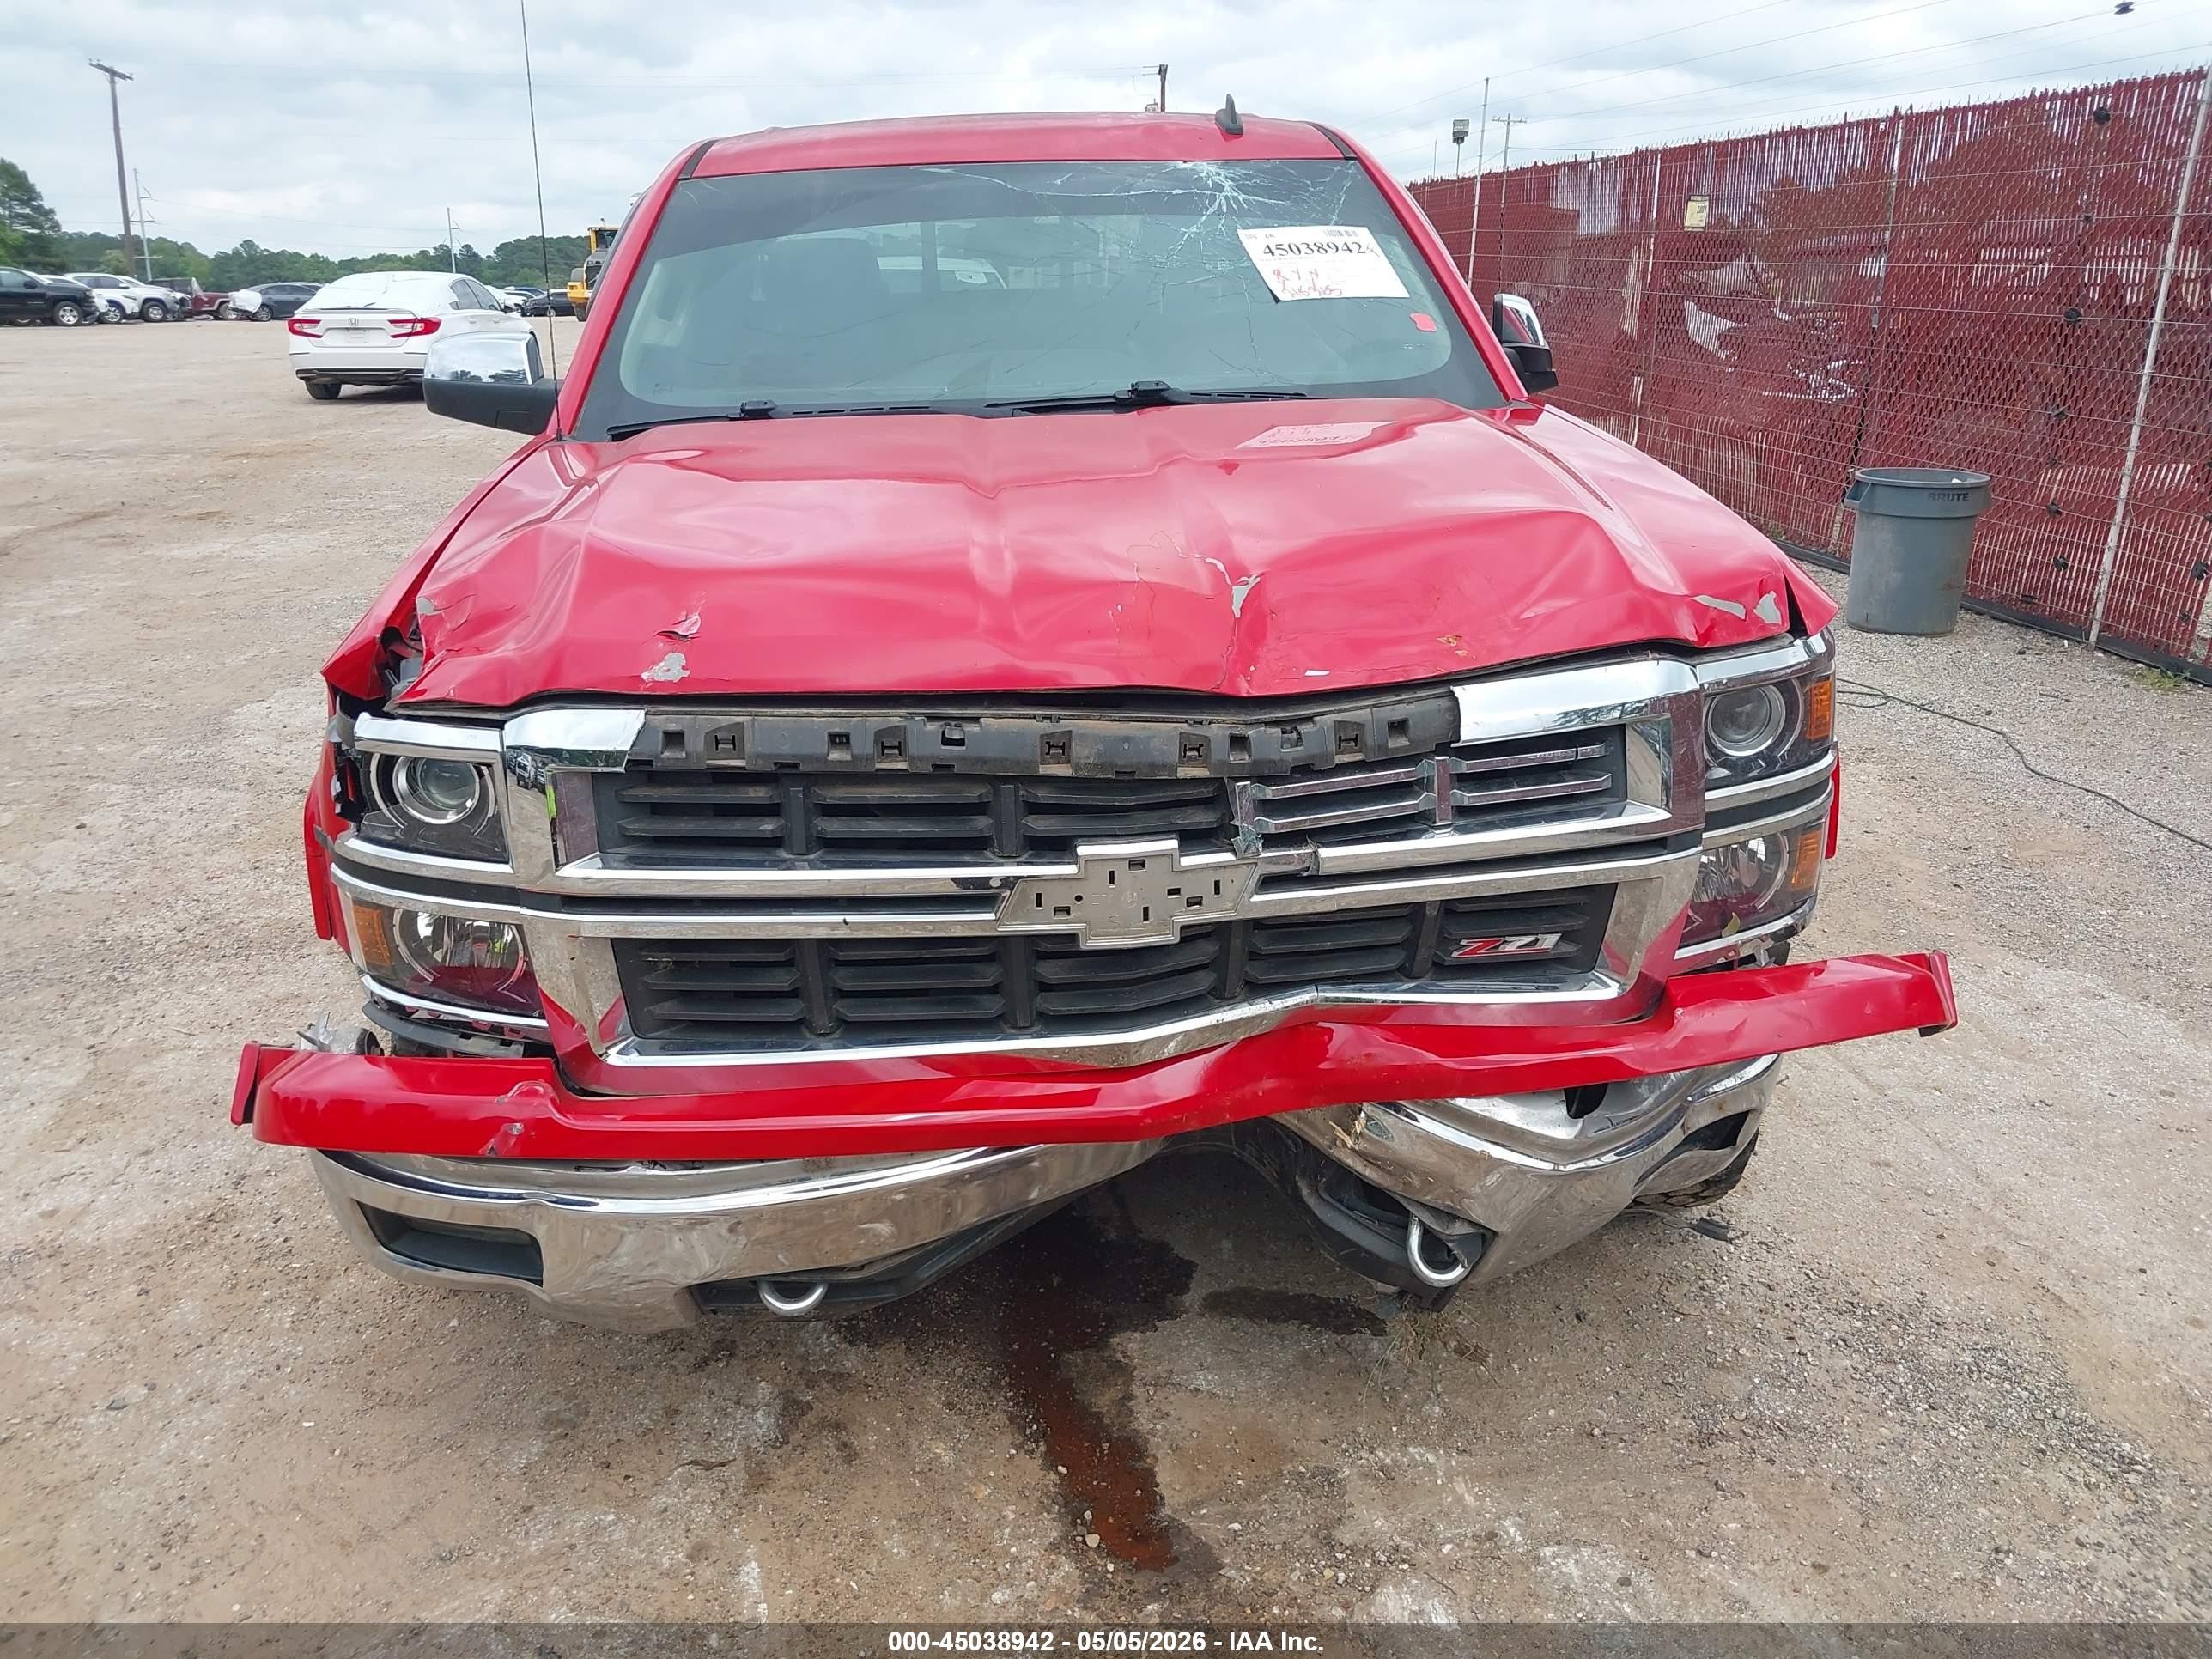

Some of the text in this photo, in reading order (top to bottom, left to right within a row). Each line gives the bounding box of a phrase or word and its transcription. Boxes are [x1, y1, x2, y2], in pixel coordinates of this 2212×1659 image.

[1263, 241, 1366, 257] 45038942
[1928, 492, 1970, 503] BRUTE
[1451, 933, 1563, 959] Z71
